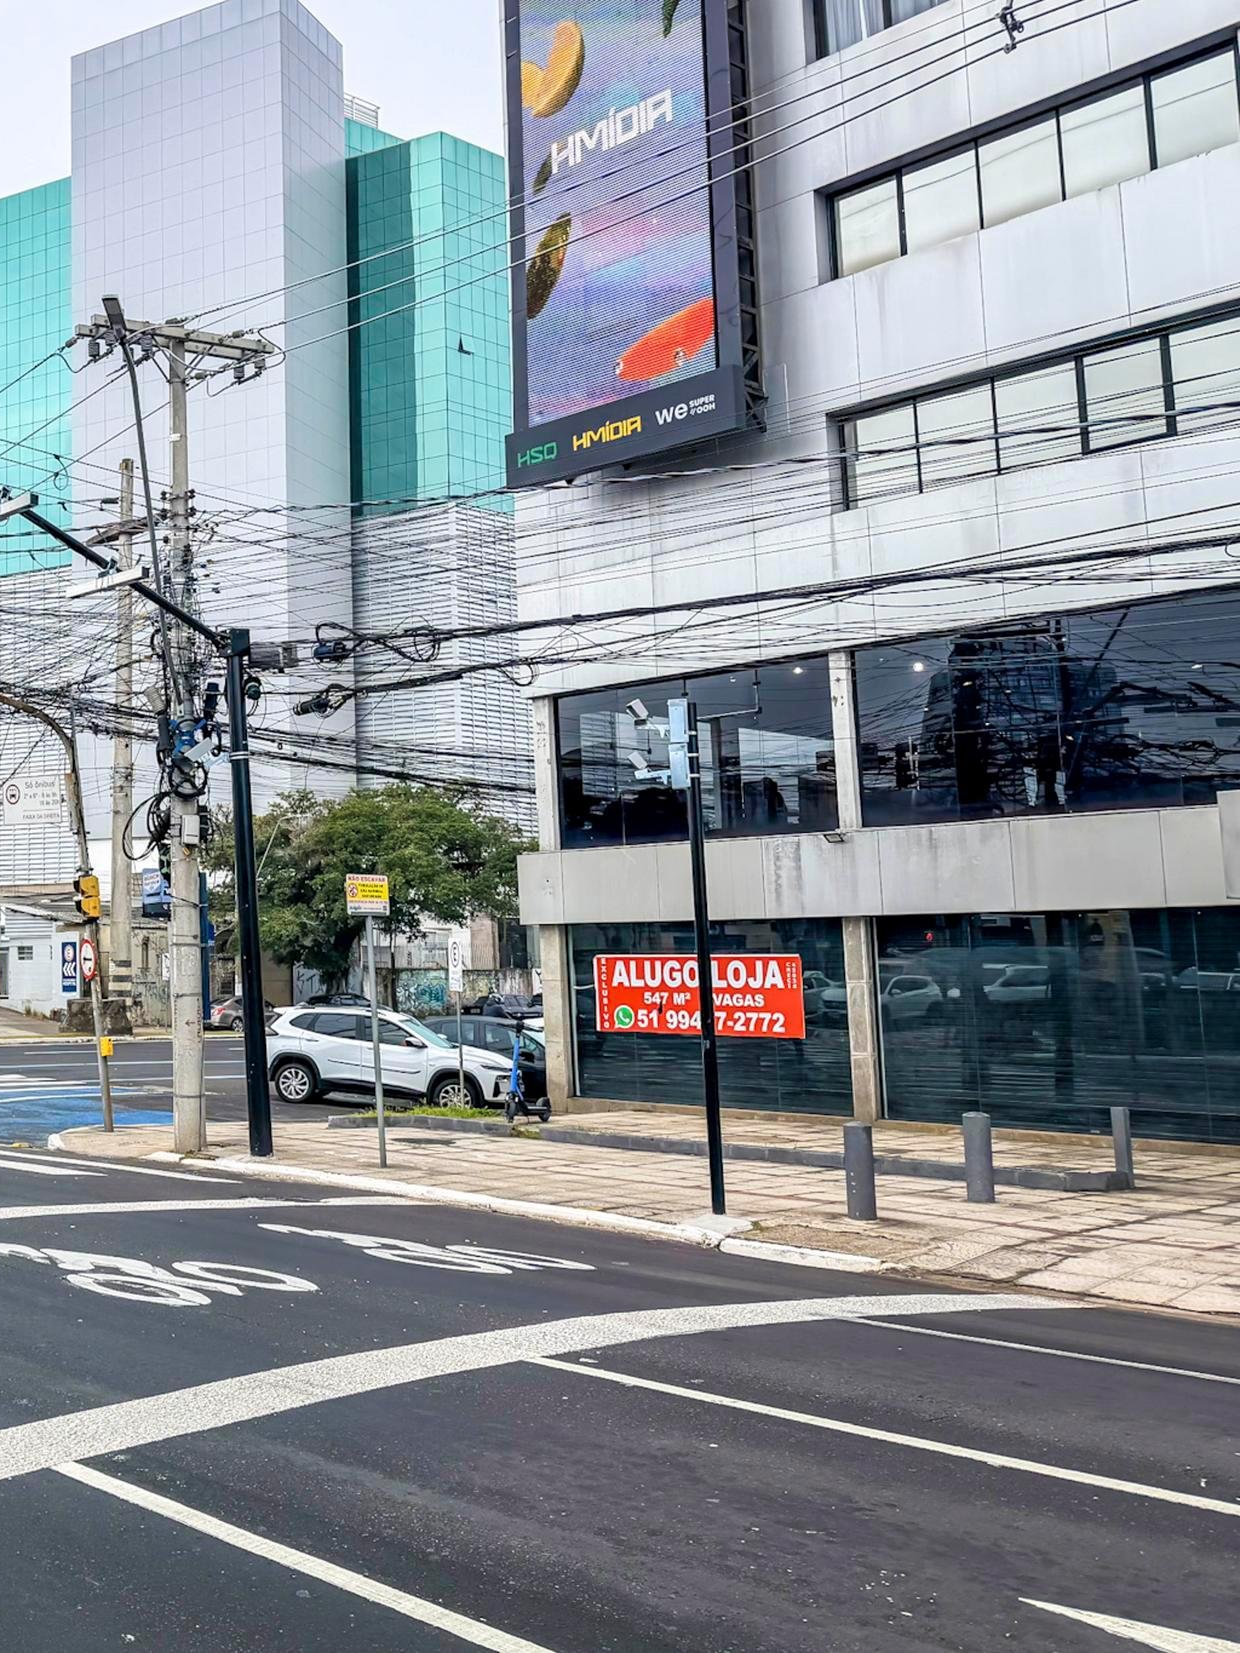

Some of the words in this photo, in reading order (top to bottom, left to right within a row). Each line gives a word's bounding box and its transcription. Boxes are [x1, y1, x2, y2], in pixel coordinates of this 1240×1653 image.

[550, 87, 673, 175] HMÍDIA
[689, 394, 715, 407] SUPER
[572, 415, 642, 451] HMÍDIA
[612, 960, 700, 988] ALUGO
[711, 960, 784, 989] LOJA
[600, 957, 609, 1029] EXCLUSIVO
[643, 991, 669, 1005] 547
[673, 992, 691, 1005] M²
[712, 993, 765, 1007] VAGAS
[637, 1009, 659, 1029] 51
[666, 1010, 786, 1033] 9947-2772
